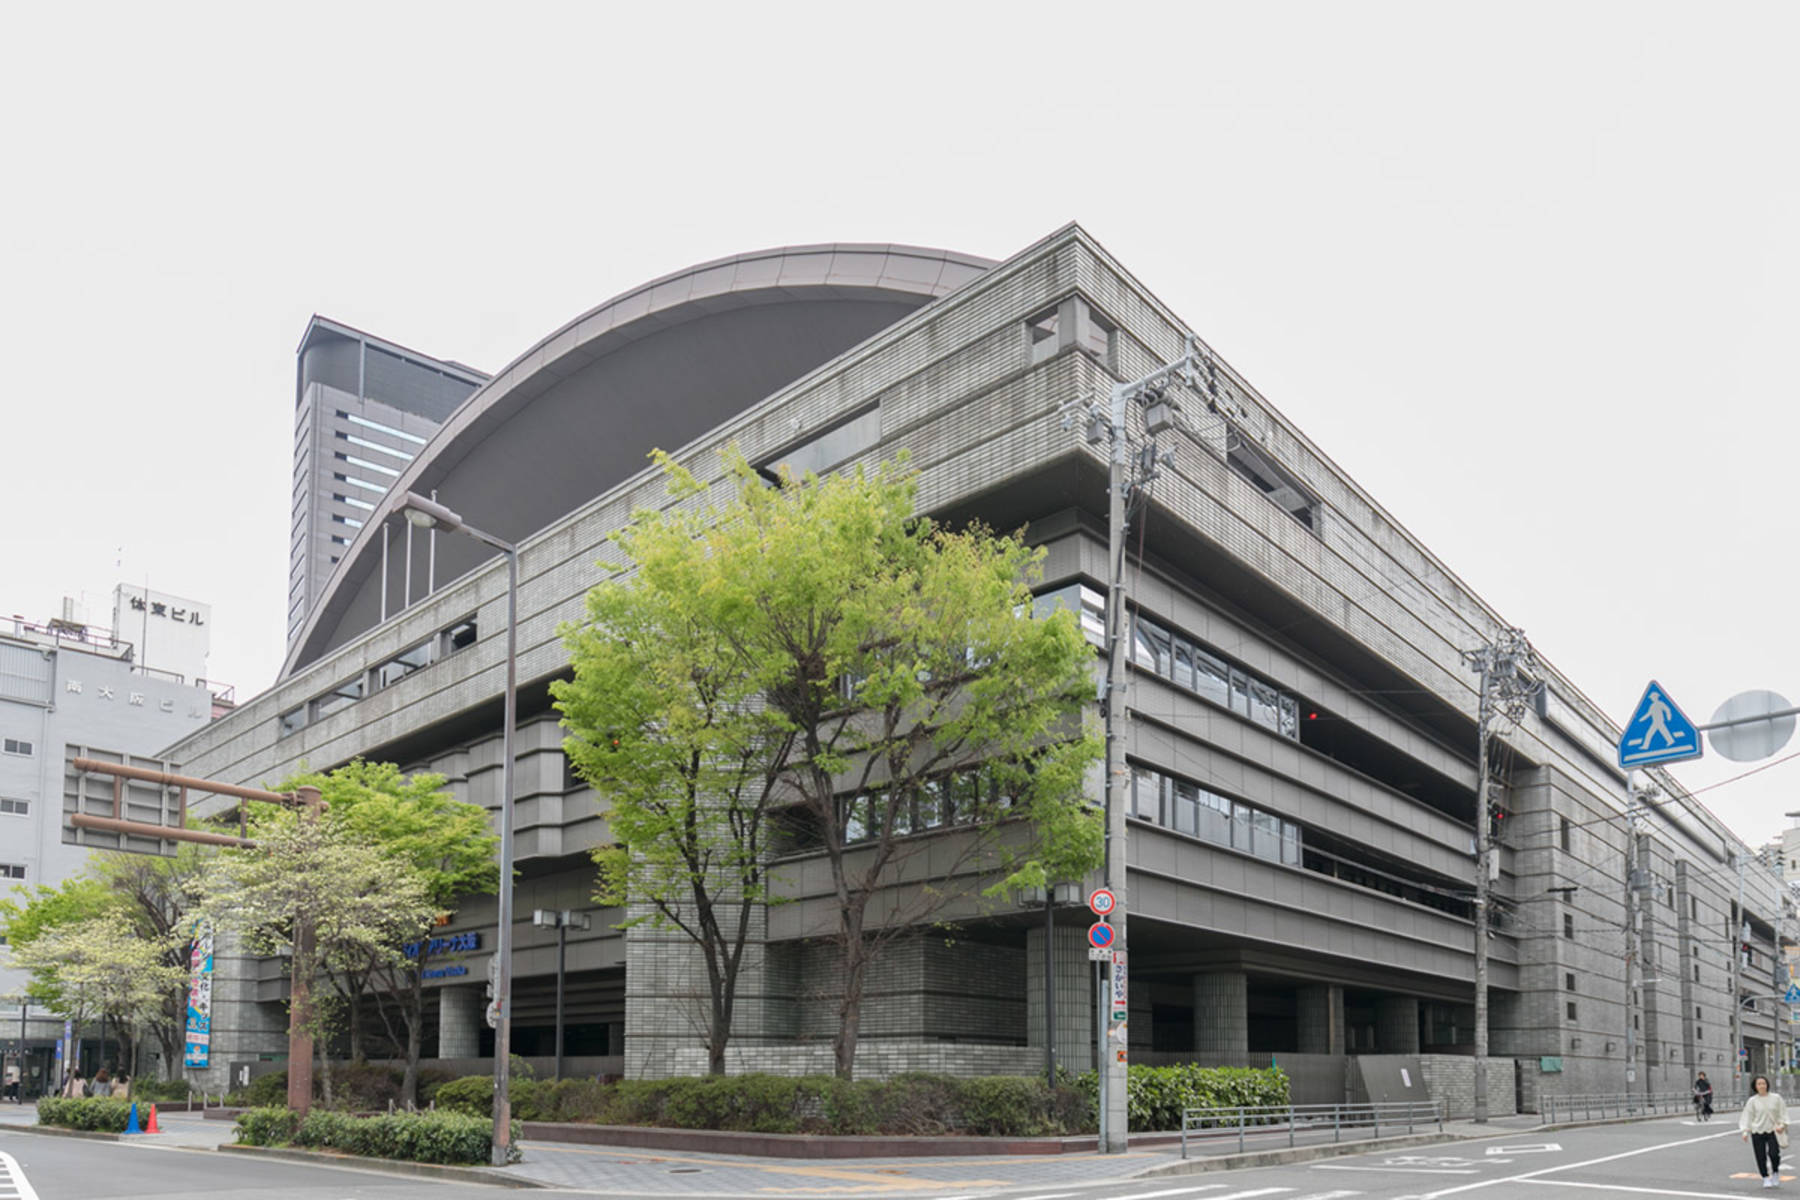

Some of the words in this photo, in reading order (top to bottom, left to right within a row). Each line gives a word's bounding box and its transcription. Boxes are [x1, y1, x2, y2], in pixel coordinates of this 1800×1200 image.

[65, 681, 202, 718] 南大阪ビル
[1095, 896, 1110, 908] 30
